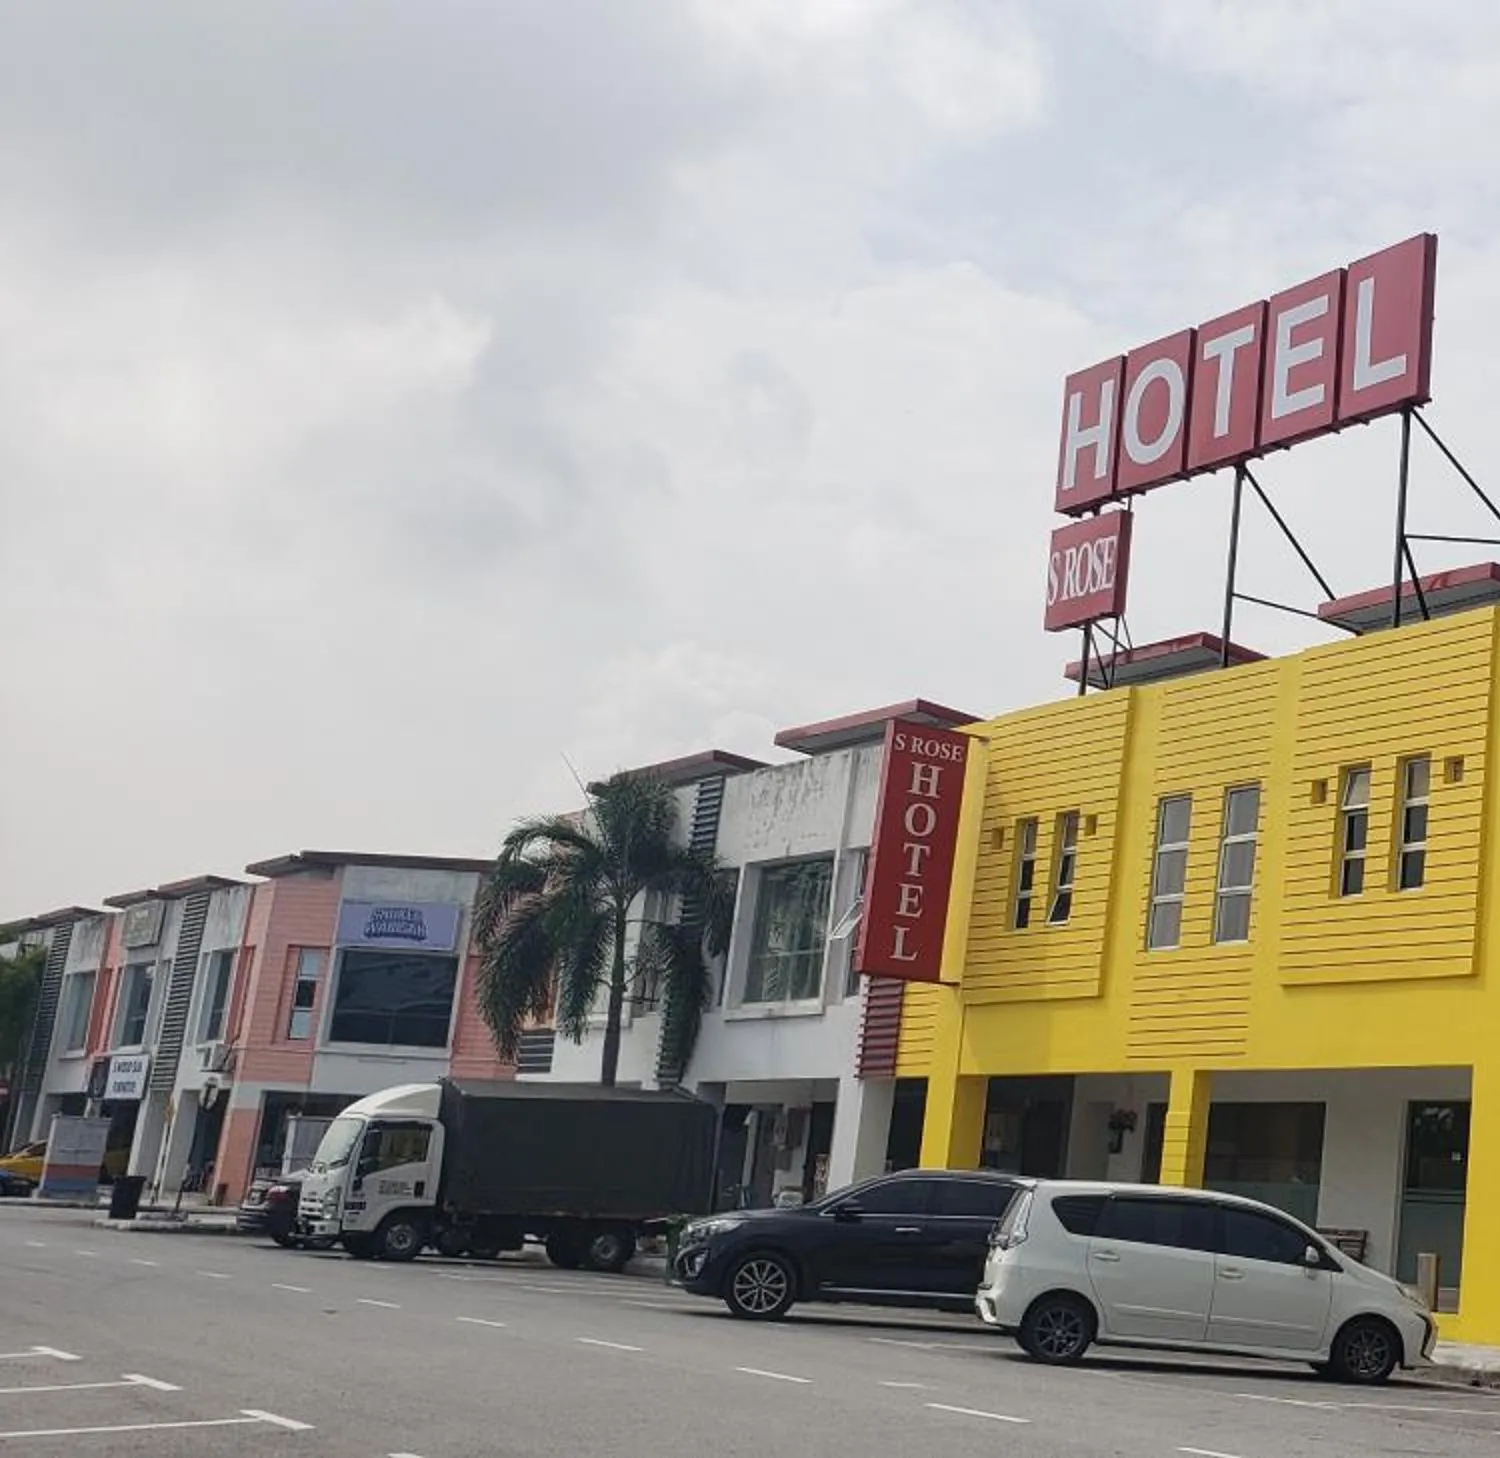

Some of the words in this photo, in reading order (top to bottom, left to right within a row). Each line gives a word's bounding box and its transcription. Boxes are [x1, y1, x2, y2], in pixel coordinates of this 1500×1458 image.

[1061, 276, 1407, 491] HOTEL
[1047, 551, 1061, 606] S
[1060, 536, 1117, 600] ROSE
[895, 733, 906, 751] S
[910, 736, 964, 762] ROSE
[889, 761, 944, 961] HOTEL
